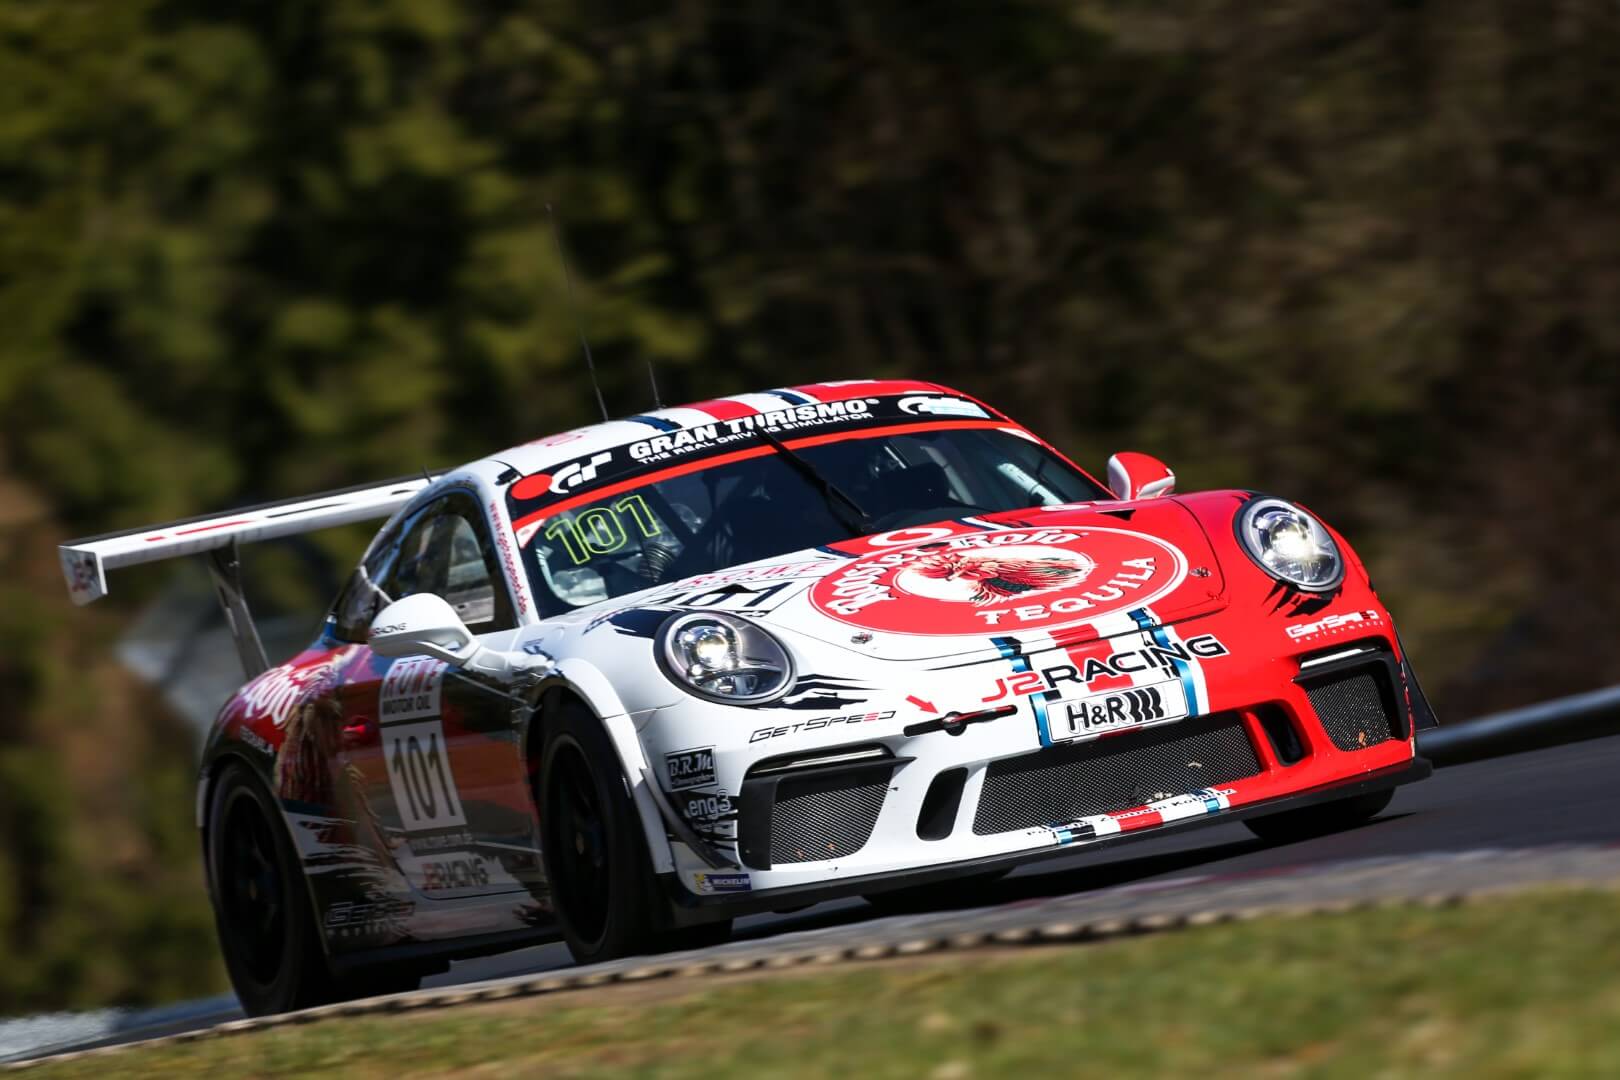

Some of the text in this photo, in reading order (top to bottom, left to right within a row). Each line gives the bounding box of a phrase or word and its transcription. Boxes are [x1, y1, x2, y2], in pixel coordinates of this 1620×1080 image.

[629, 424, 718, 459] GRAN
[637, 451, 672, 464] THE
[673, 440, 716, 456] REAL
[783, 412, 874, 430] SIMULATOR
[545, 494, 661, 565] 101
[975, 556, 1156, 626] TEQUILA
[981, 634, 1229, 703] J2RACING
[415, 694, 432, 711] OIL
[1066, 696, 1128, 732] H&R
[393, 733, 456, 821] 101
